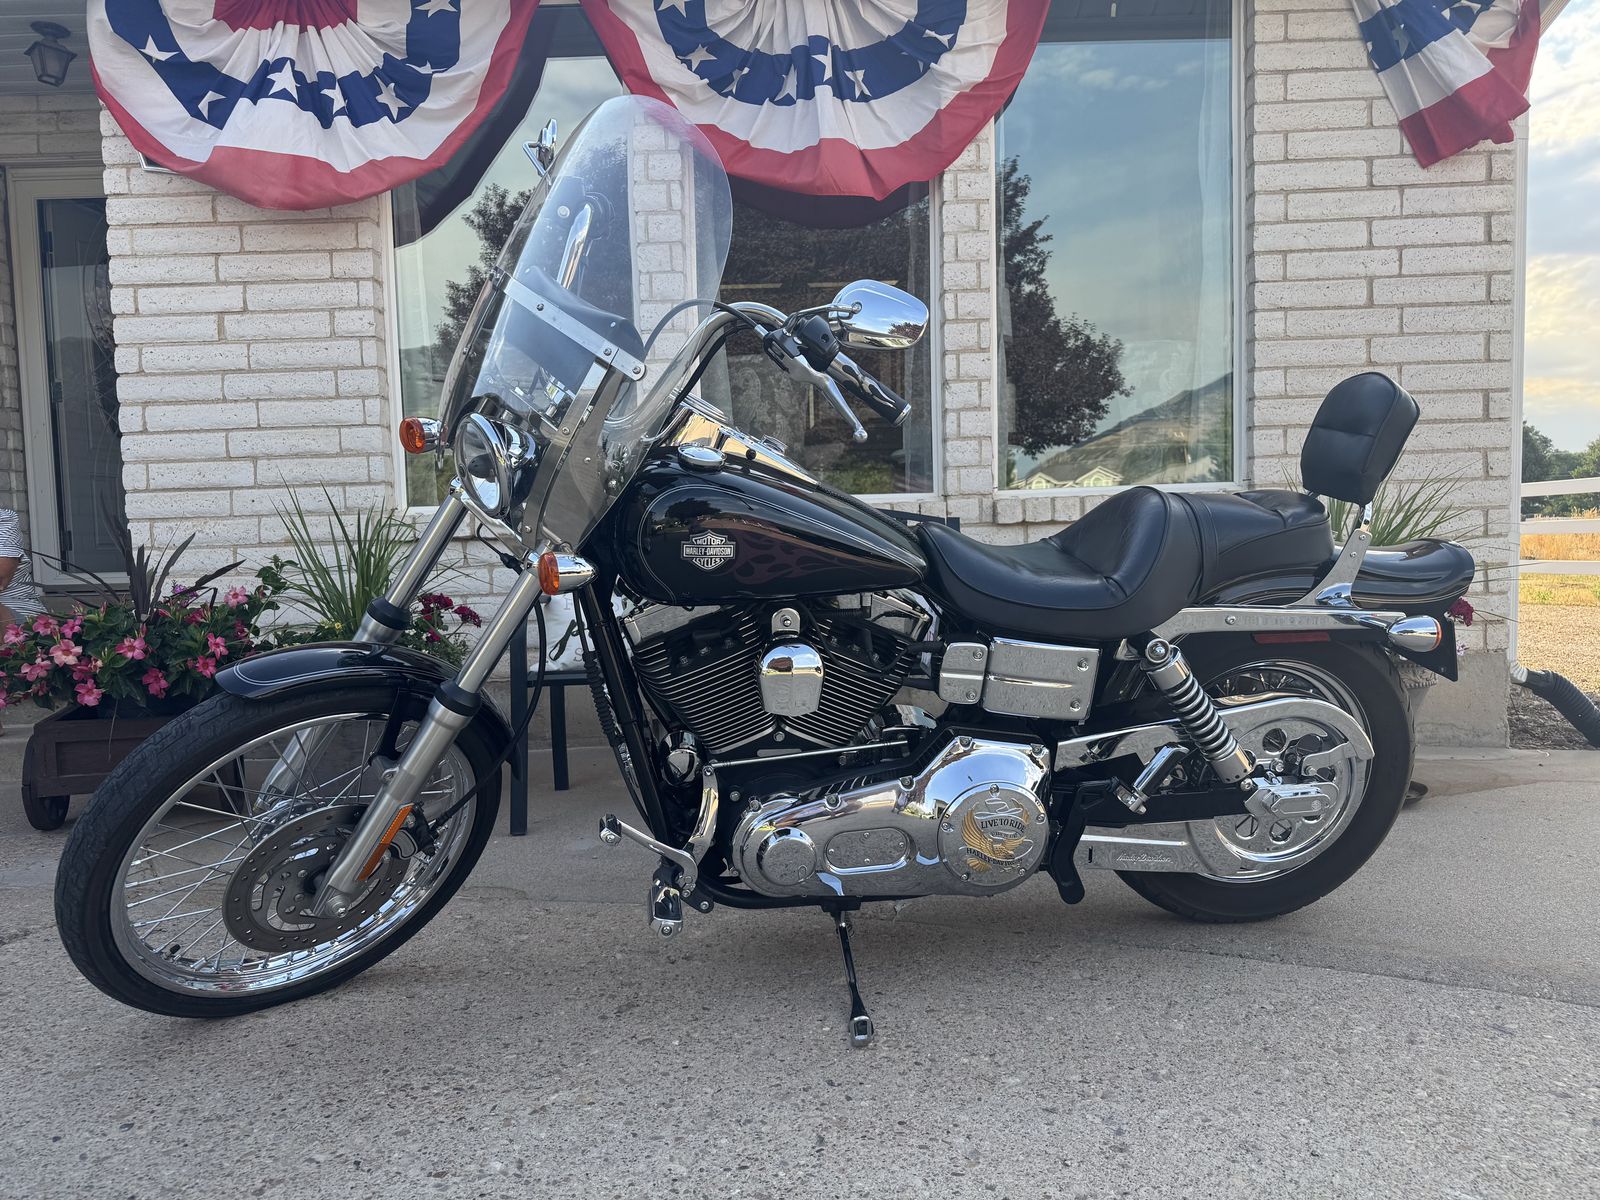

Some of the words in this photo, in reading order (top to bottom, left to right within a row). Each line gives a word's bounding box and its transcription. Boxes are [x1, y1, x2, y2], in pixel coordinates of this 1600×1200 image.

[696, 535, 721, 545] MOTOR
[685, 547, 731, 556] HARLEY-DAVIDSON
[696, 558, 720, 568] CYCLES
[981, 819, 998, 828] LIVE
[1000, 818, 1009, 826] TO
[1010, 819, 1026, 832] RIDE
